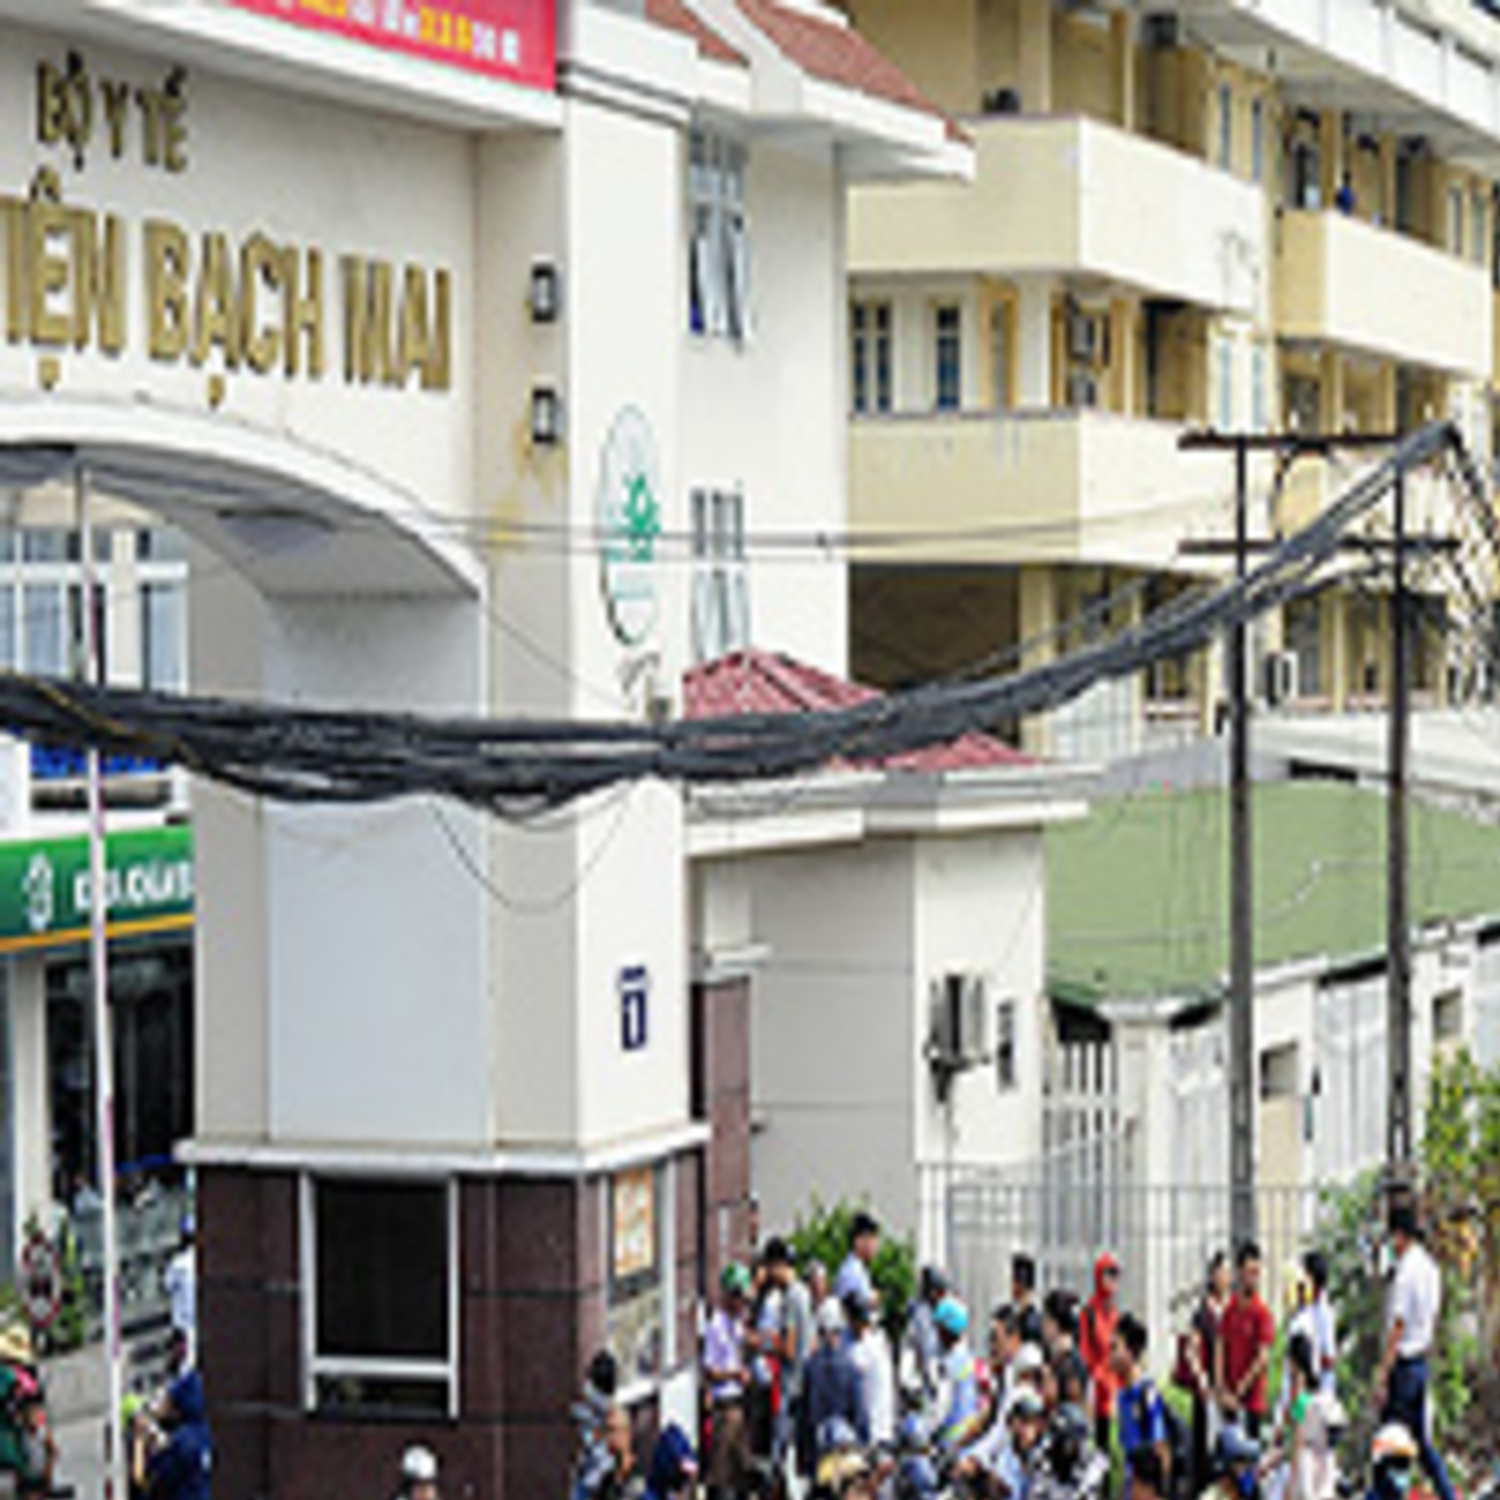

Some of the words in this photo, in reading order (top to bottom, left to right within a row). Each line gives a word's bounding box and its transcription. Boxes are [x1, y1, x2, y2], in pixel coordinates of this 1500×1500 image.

[36, 50, 91, 172] BỘ
[100, 78, 129, 160] Y
[134, 63, 187, 174] TẾ
[143, 218, 323, 406] BẠCH
[338, 255, 452, 391] MAI
